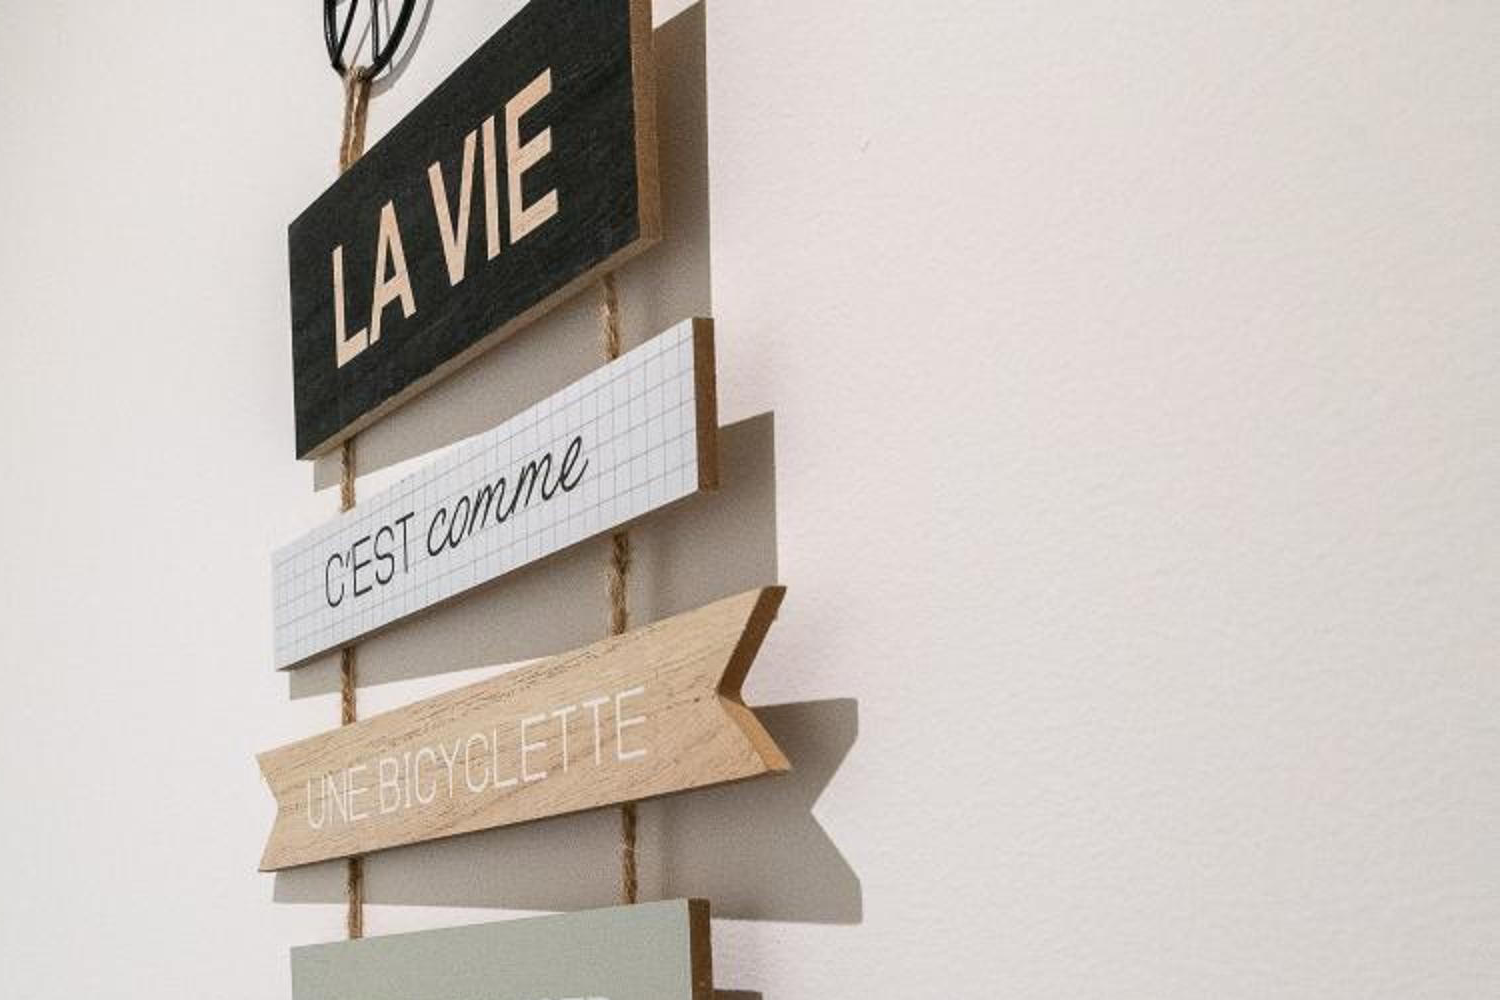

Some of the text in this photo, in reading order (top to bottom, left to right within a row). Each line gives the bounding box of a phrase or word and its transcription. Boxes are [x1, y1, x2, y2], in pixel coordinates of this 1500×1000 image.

[332, 67, 559, 369] LA VIE
[324, 435, 589, 608] C'EST comme
[307, 687, 647, 829] UNE BICYCLETTE
